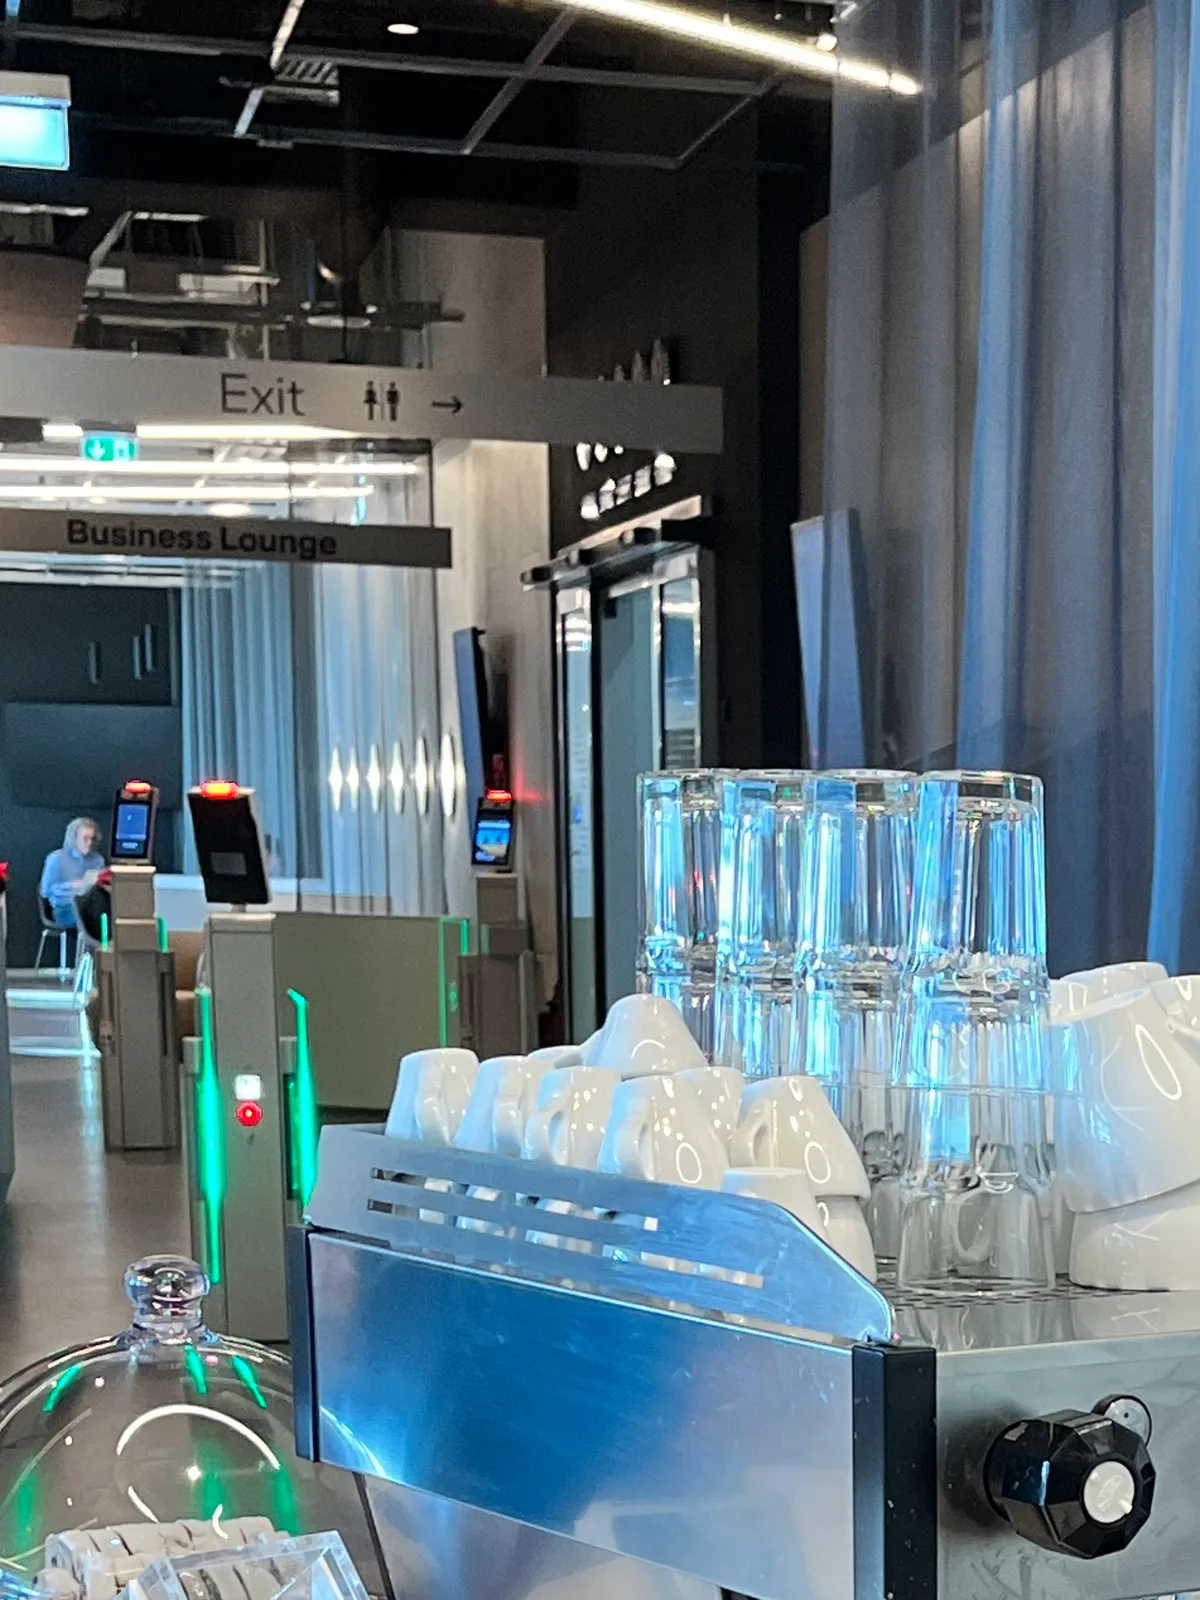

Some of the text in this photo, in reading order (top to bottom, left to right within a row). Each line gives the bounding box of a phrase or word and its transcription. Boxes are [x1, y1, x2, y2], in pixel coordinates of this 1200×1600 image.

[222, 373, 306, 416] Exit
[67, 519, 338, 559] Business Lounge
